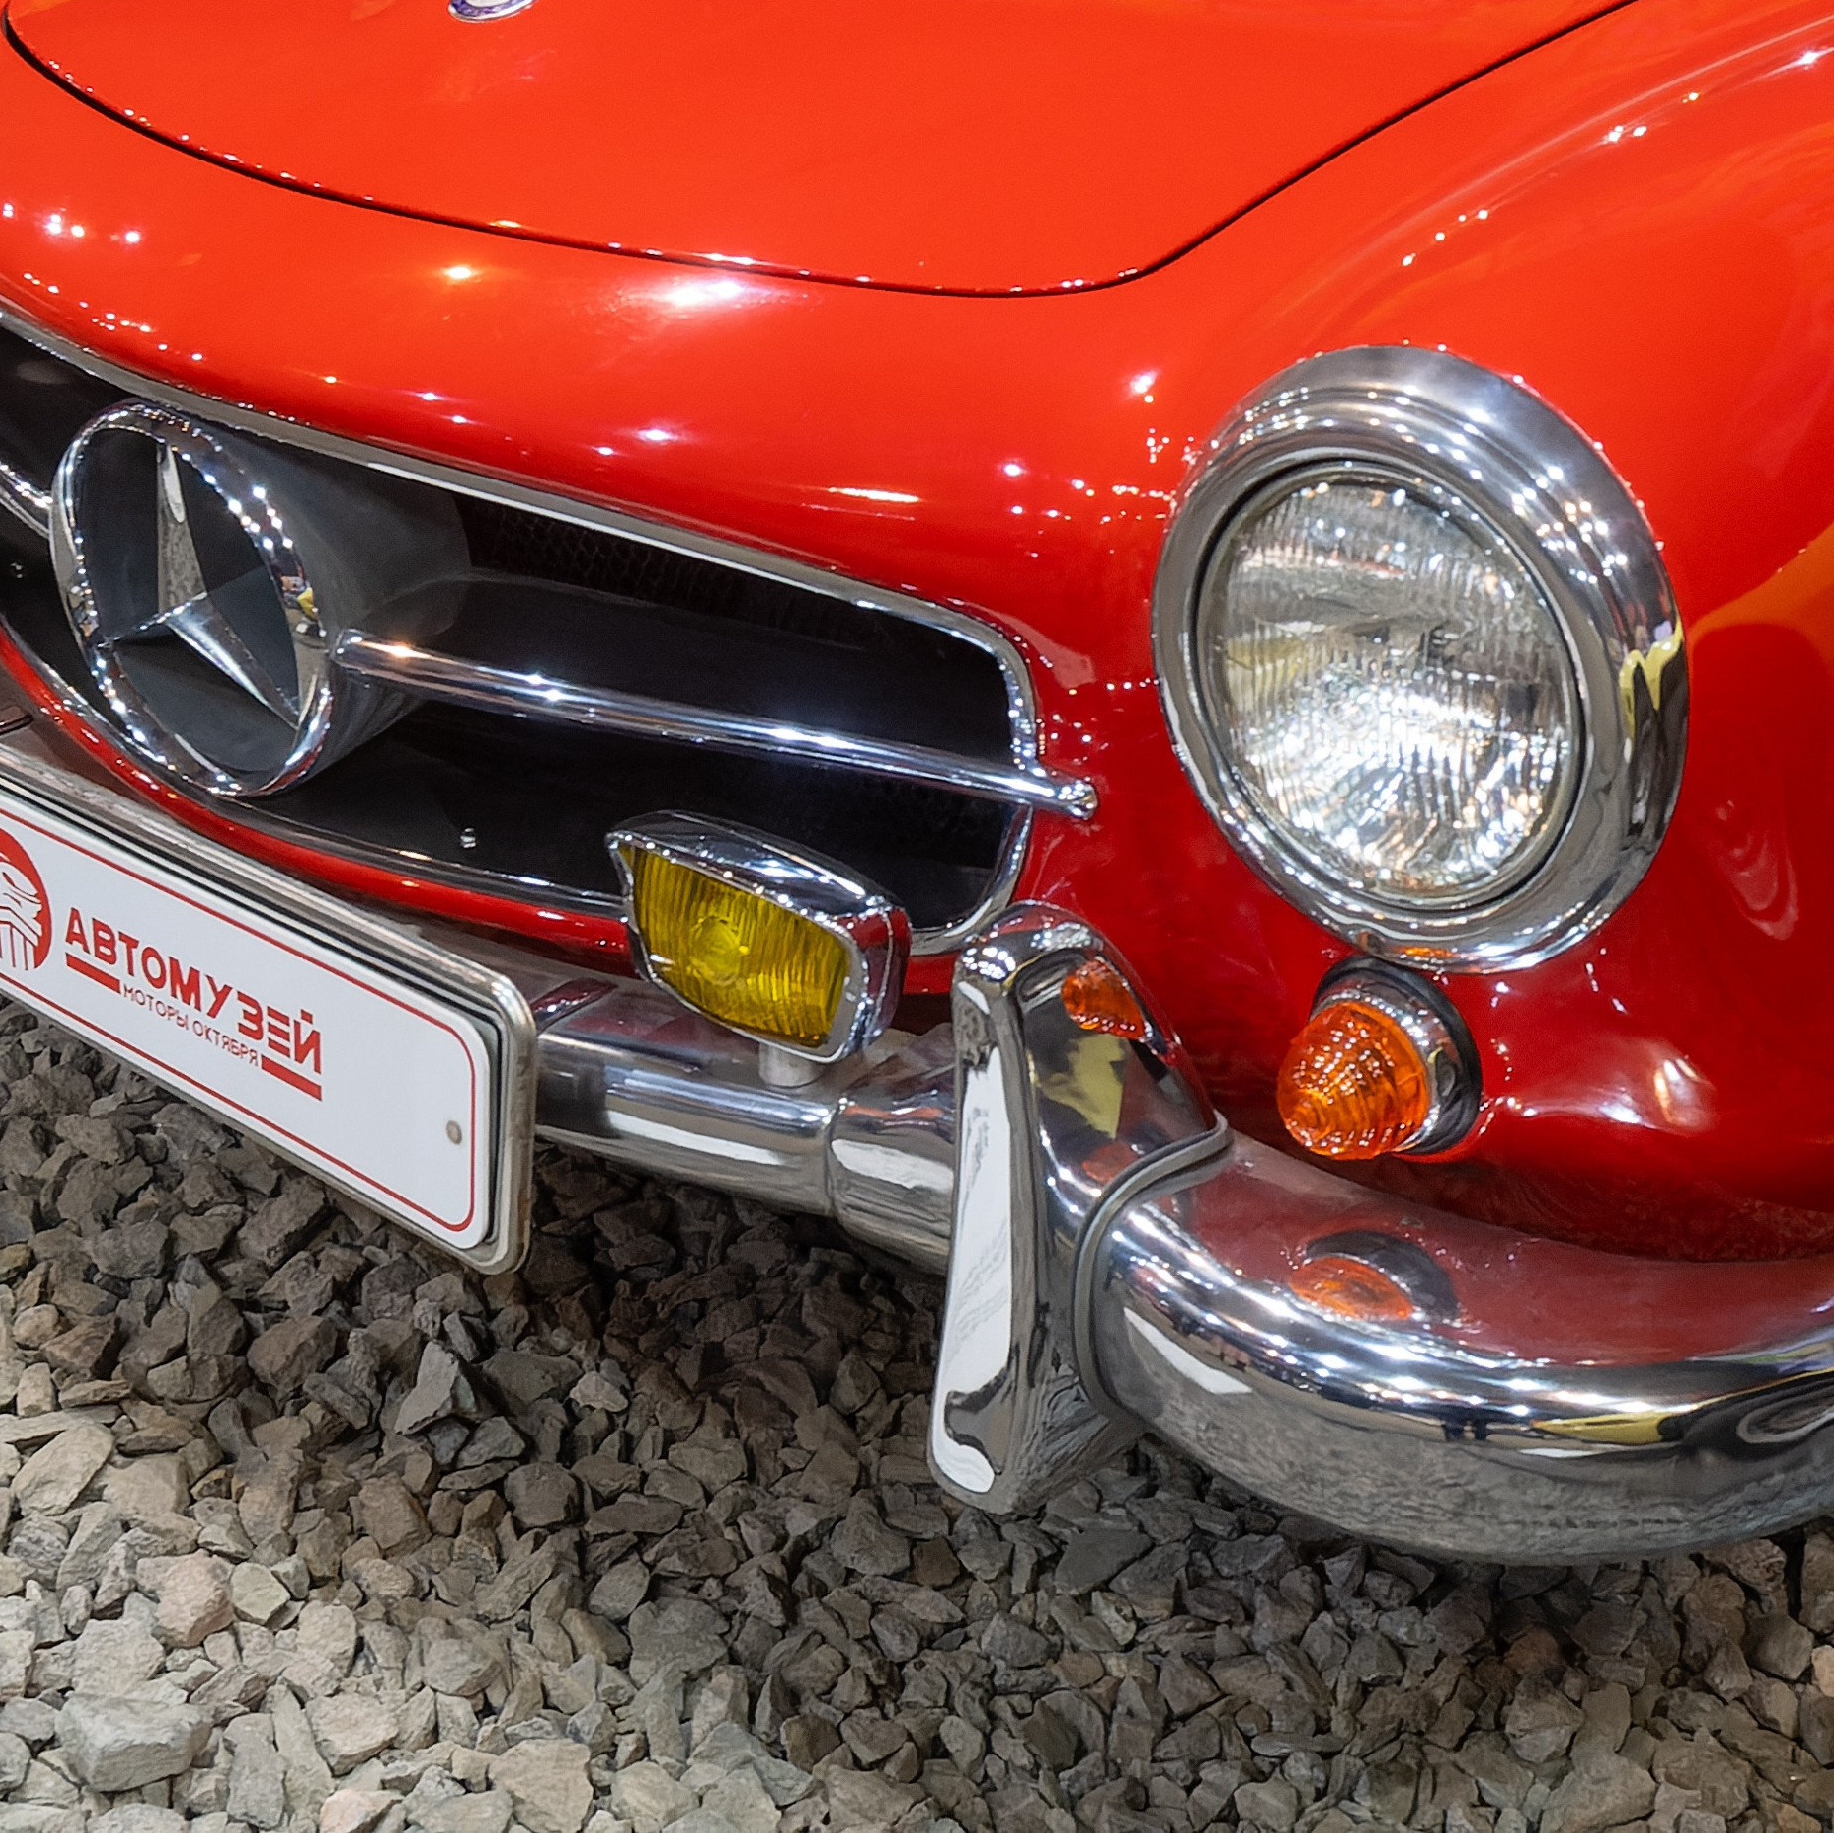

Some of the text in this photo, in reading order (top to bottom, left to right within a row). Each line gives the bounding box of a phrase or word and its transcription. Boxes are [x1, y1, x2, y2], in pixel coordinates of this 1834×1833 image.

[65, 907, 322, 1074] АВТОМУЗЕЙ
[123, 984, 259, 1066] МОТОРЫ ОКТЯБРЯ
